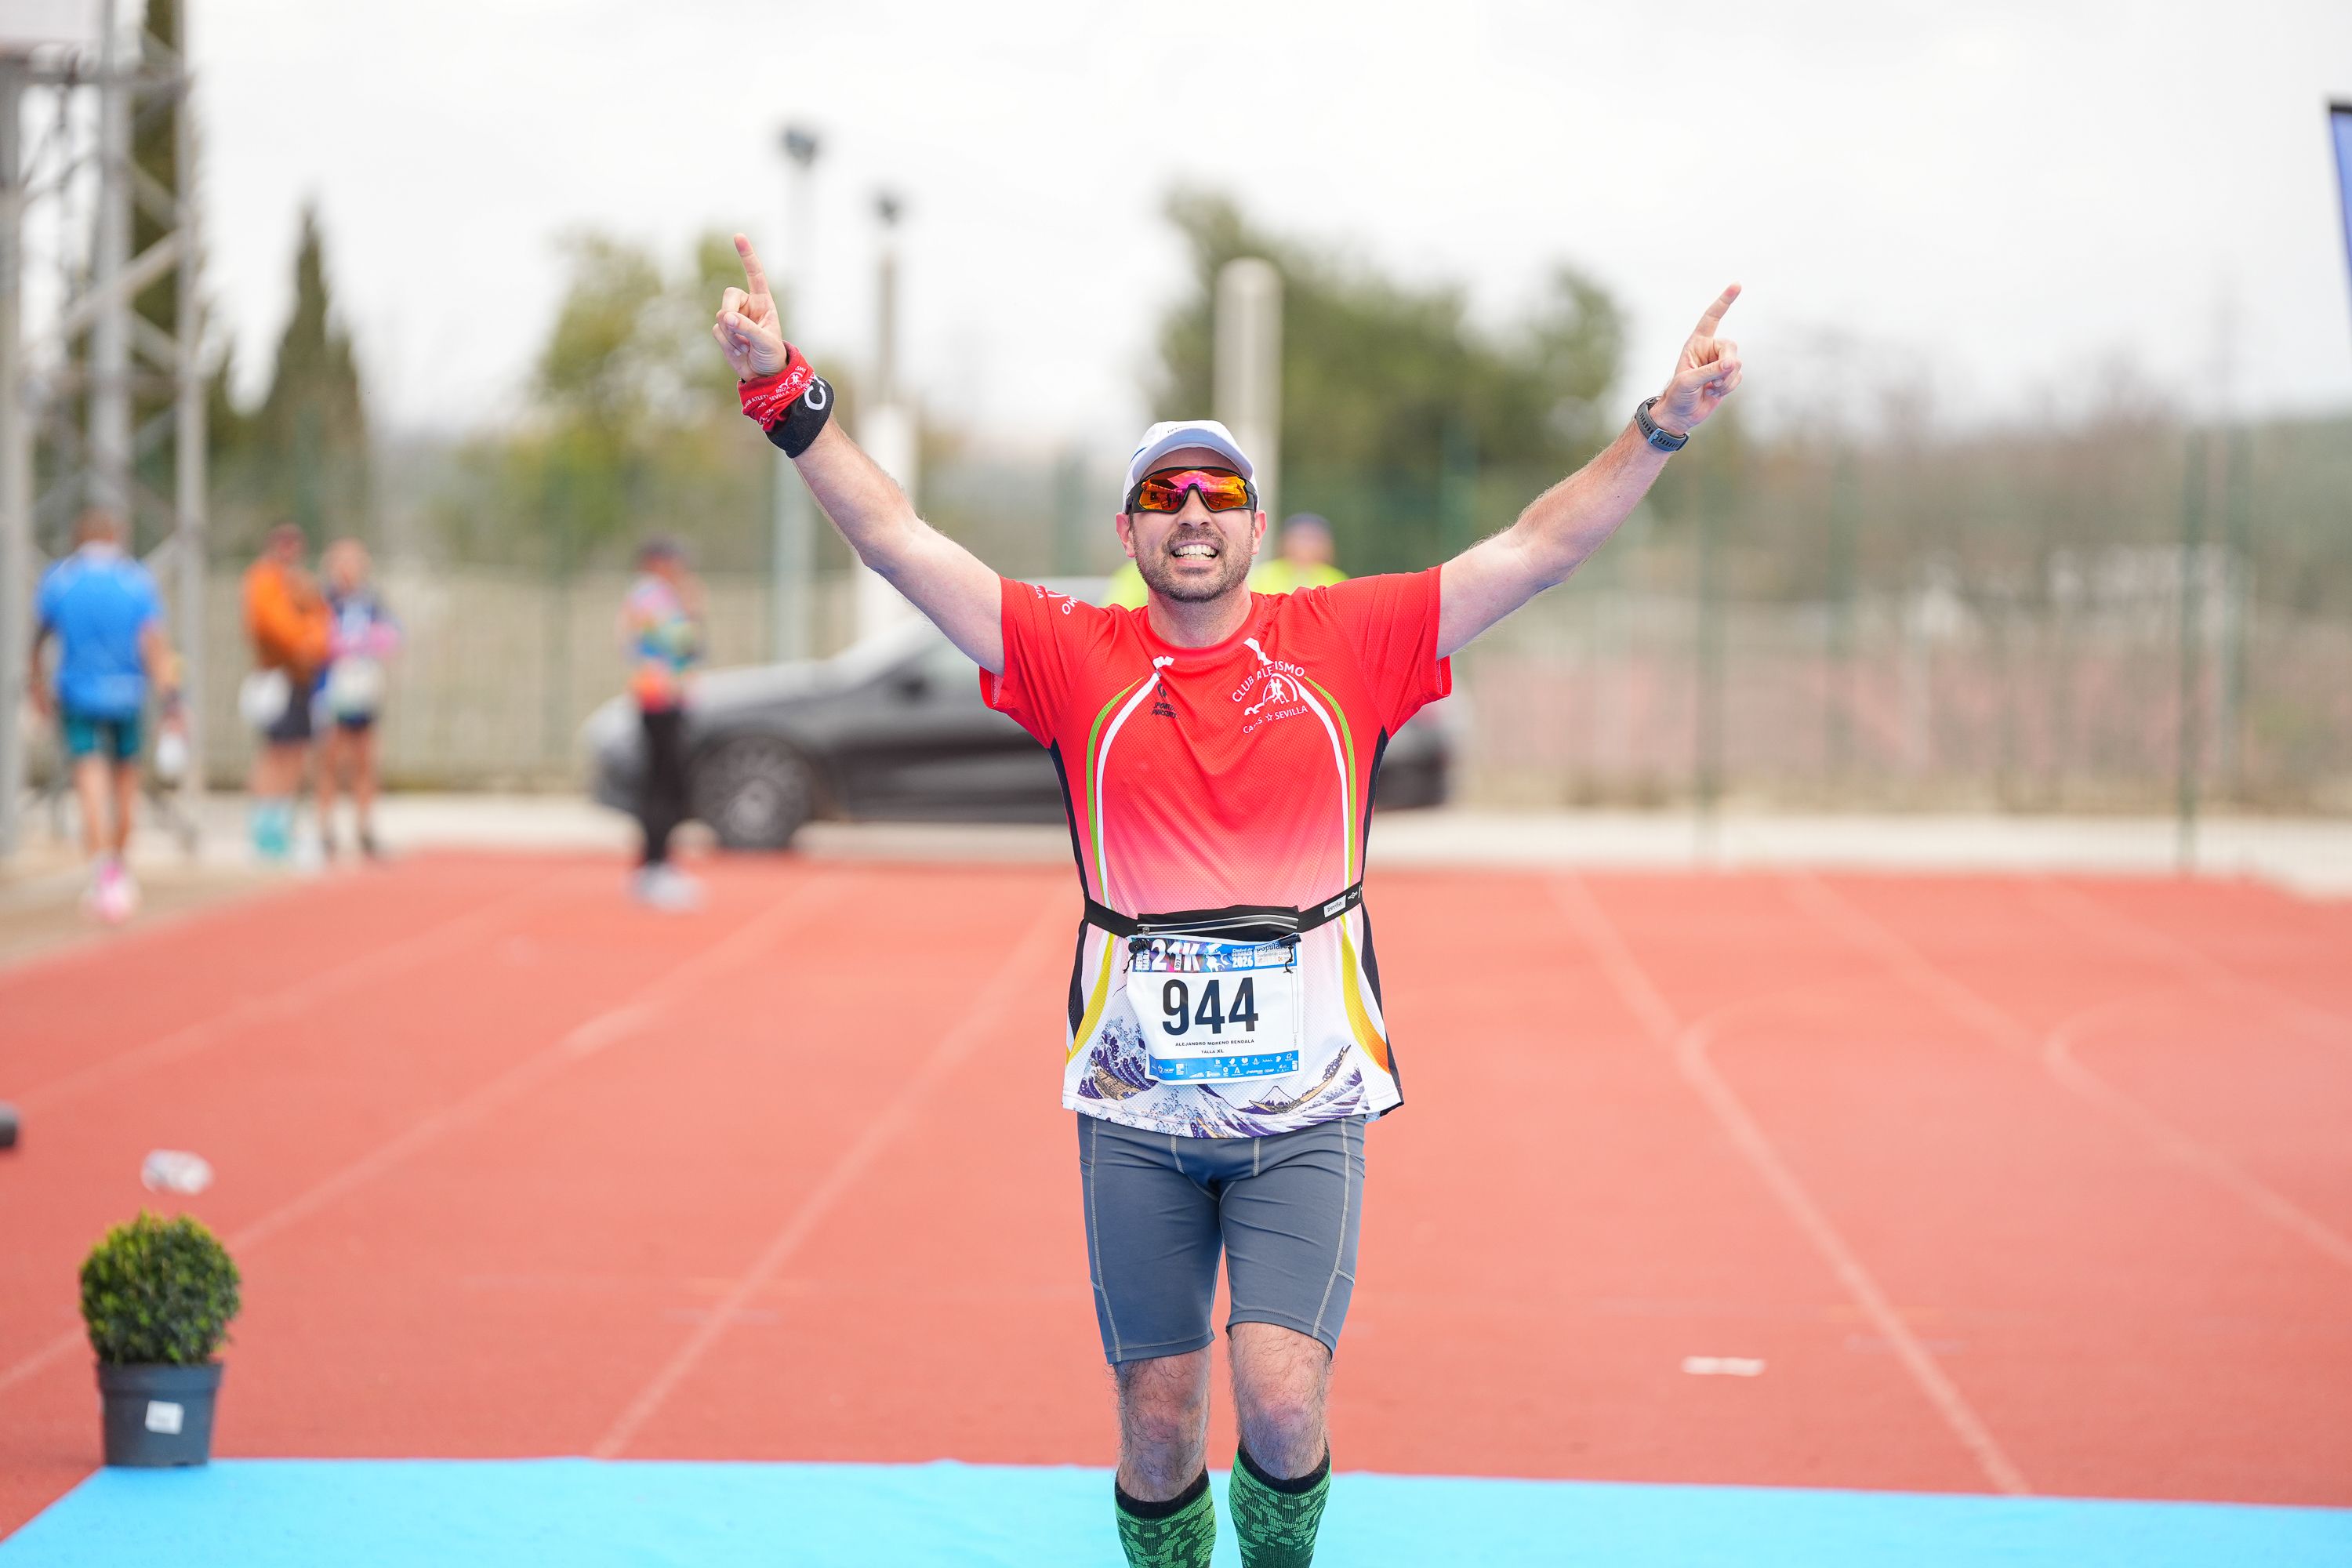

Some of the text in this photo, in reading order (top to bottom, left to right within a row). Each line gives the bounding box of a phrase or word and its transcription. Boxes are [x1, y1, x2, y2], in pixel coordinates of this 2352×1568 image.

[1232, 676, 1254, 702] CLUB
[1275, 706, 1308, 720] SEVILLA
[1151, 939, 1200, 971] 21K
[1232, 956, 1253, 968] 2026
[1163, 977, 1259, 1036] 944
